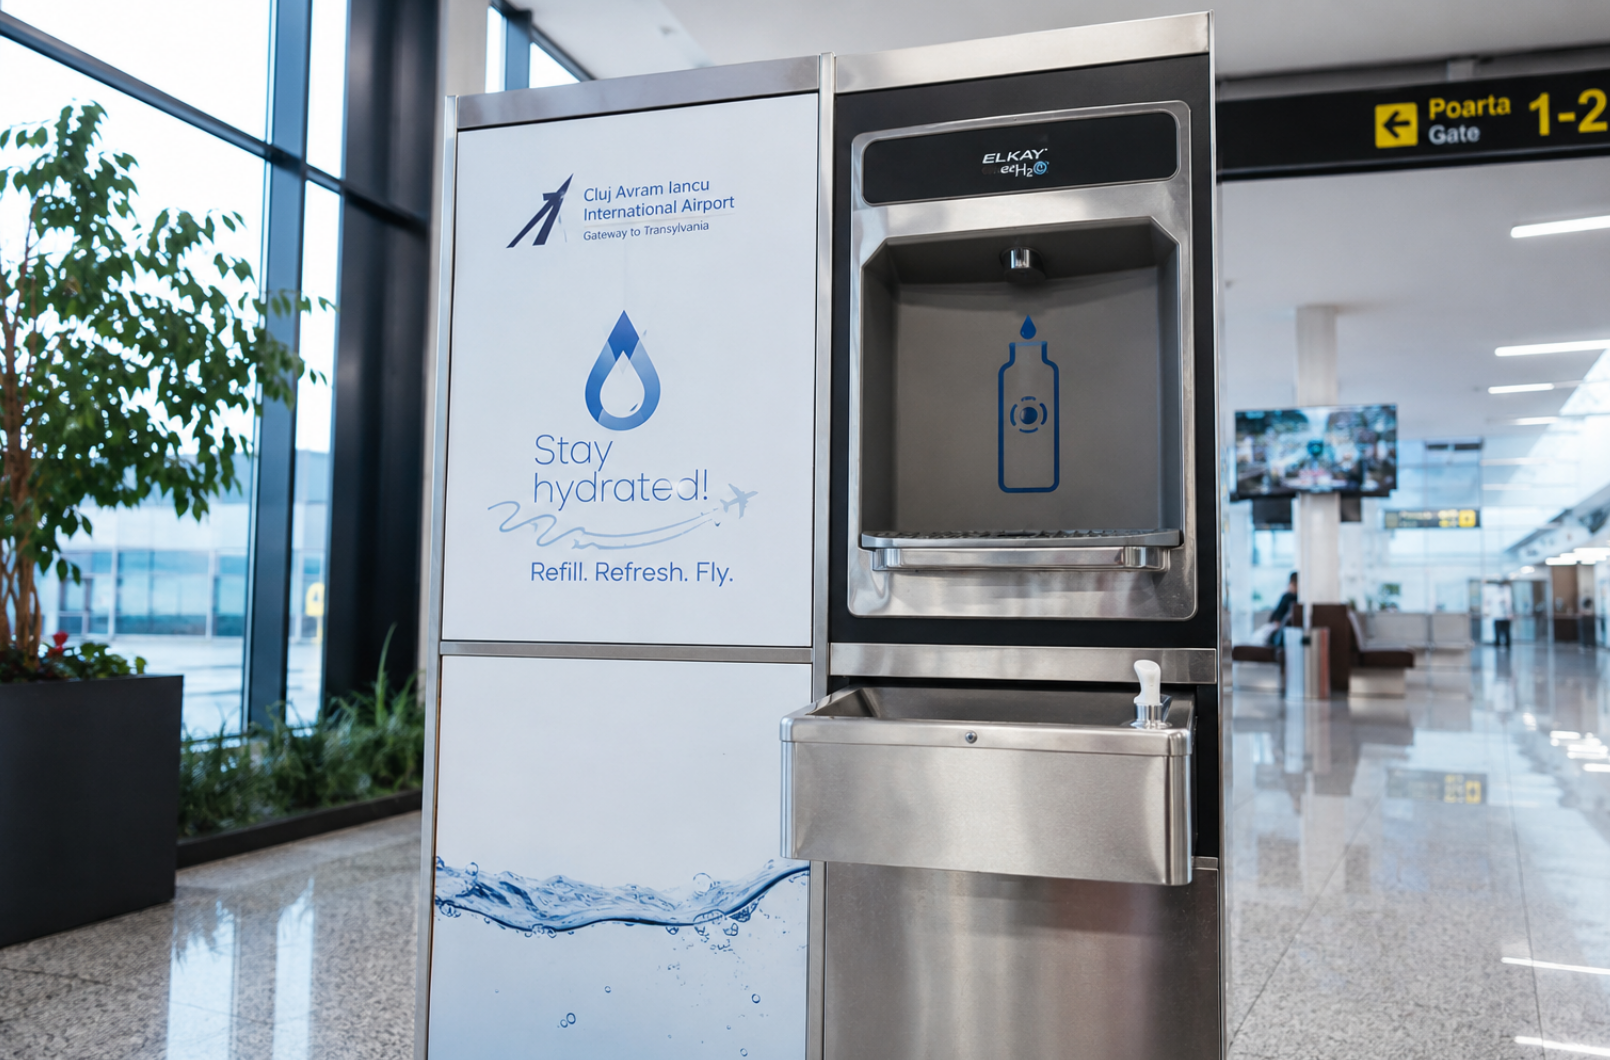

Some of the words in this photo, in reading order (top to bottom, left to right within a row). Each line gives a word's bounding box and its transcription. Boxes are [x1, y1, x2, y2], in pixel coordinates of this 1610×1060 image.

[1429, 94, 1511, 120] Poarta
[1529, 88, 1608, 136] 1-2
[1428, 124, 1481, 145] Gate
[982, 149, 1044, 164] ELKAY
[583, 187, 612, 203] Cluj
[615, 183, 664, 199] Avram
[668, 179, 710, 194] Iancu
[583, 200, 677, 221] International
[681, 196, 735, 213] Airport
[583, 228, 628, 241] Gateway
[630, 228, 641, 237] to
[643, 220, 710, 236] Transylvania
[534, 434, 613, 472] Stay
[533, 469, 708, 511] hydrated!
[530, 561, 588, 582] Refill.
[595, 561, 688, 582] Refresh.
[696, 561, 734, 587] Fly.
